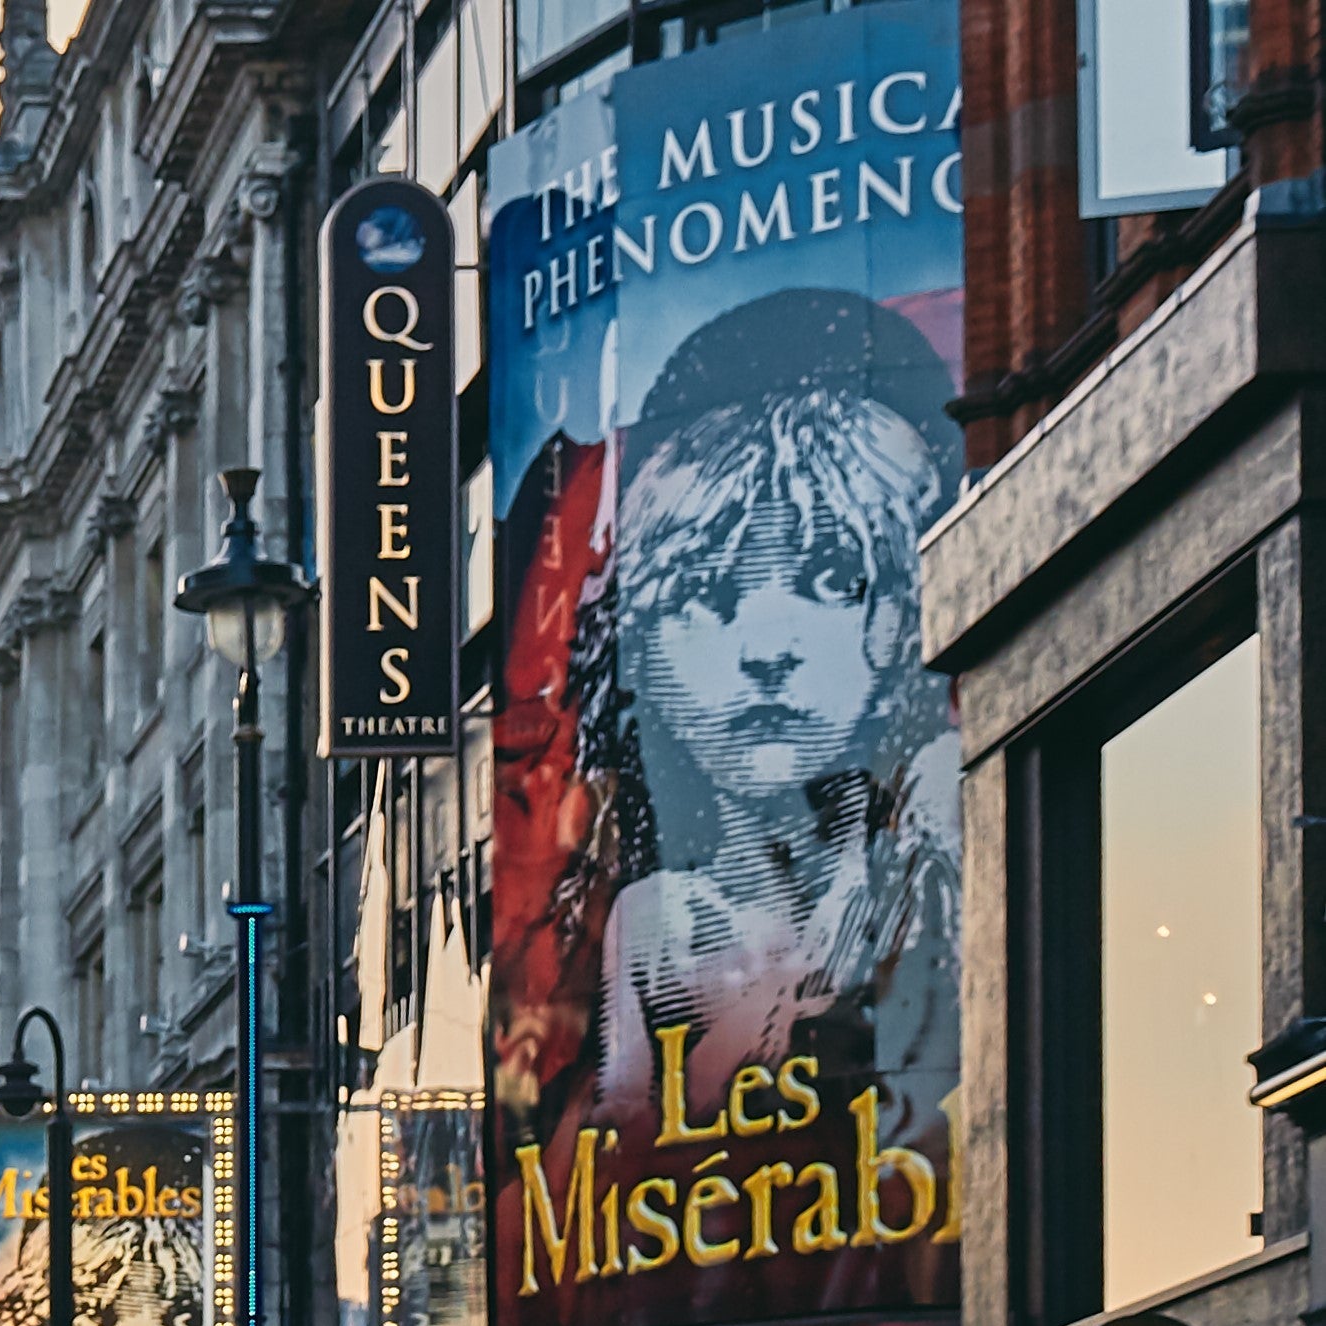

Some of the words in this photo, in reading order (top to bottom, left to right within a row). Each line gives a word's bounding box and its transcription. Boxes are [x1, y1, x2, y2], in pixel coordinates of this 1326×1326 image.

[536, 144, 619, 242] THE
[362, 286, 434, 704] QUEENS
[341, 716, 449, 736] THEATRE
[654, 1022, 821, 1148] Les
